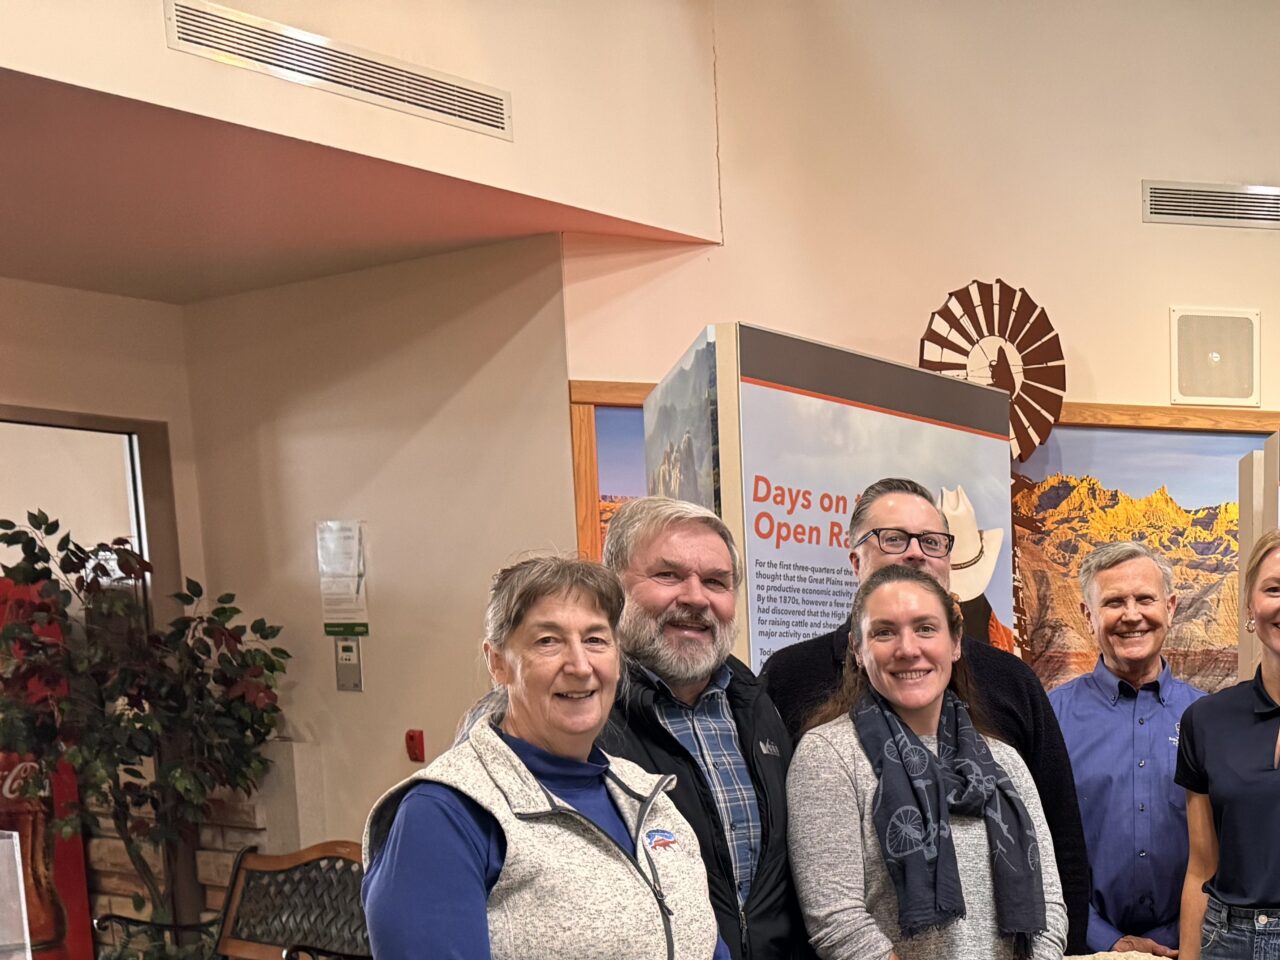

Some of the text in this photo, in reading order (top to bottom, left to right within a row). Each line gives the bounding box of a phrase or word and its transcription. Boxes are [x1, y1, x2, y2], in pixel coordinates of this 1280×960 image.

[753, 475, 848, 515] Days on
[754, 511, 821, 549] Open
[755, 559, 766, 568] For
[767, 560, 778, 569] the
[779, 561, 792, 571] first
[793, 562, 835, 574] three-quarters
[843, 568, 853, 576] the
[755, 571, 782, 582] thought
[783, 573, 796, 582] that
[797, 574, 807, 583] the
[808, 575, 825, 585] Great
[825, 577, 844, 586] Plains
[766, 583, 800, 594] productive
[801, 587, 831, 596] economic
[832, 589, 853, 600] activity
[757, 594, 765, 604] By
[767, 594, 777, 603] the
[801, 598, 828, 607] however
[833, 599, 845, 608] few
[757, 606, 770, 614] had
[771, 607, 806, 617] discovered
[807, 609, 819, 617] that
[820, 609, 830, 618] the
[831, 610, 845, 620] High
[757, 617, 768, 625] for
[768, 618, 790, 628] raising
[791, 619, 808, 628] cattle
[809, 620, 821, 629] and
[758, 630, 778, 639] major
[778, 629, 801, 640] activity
